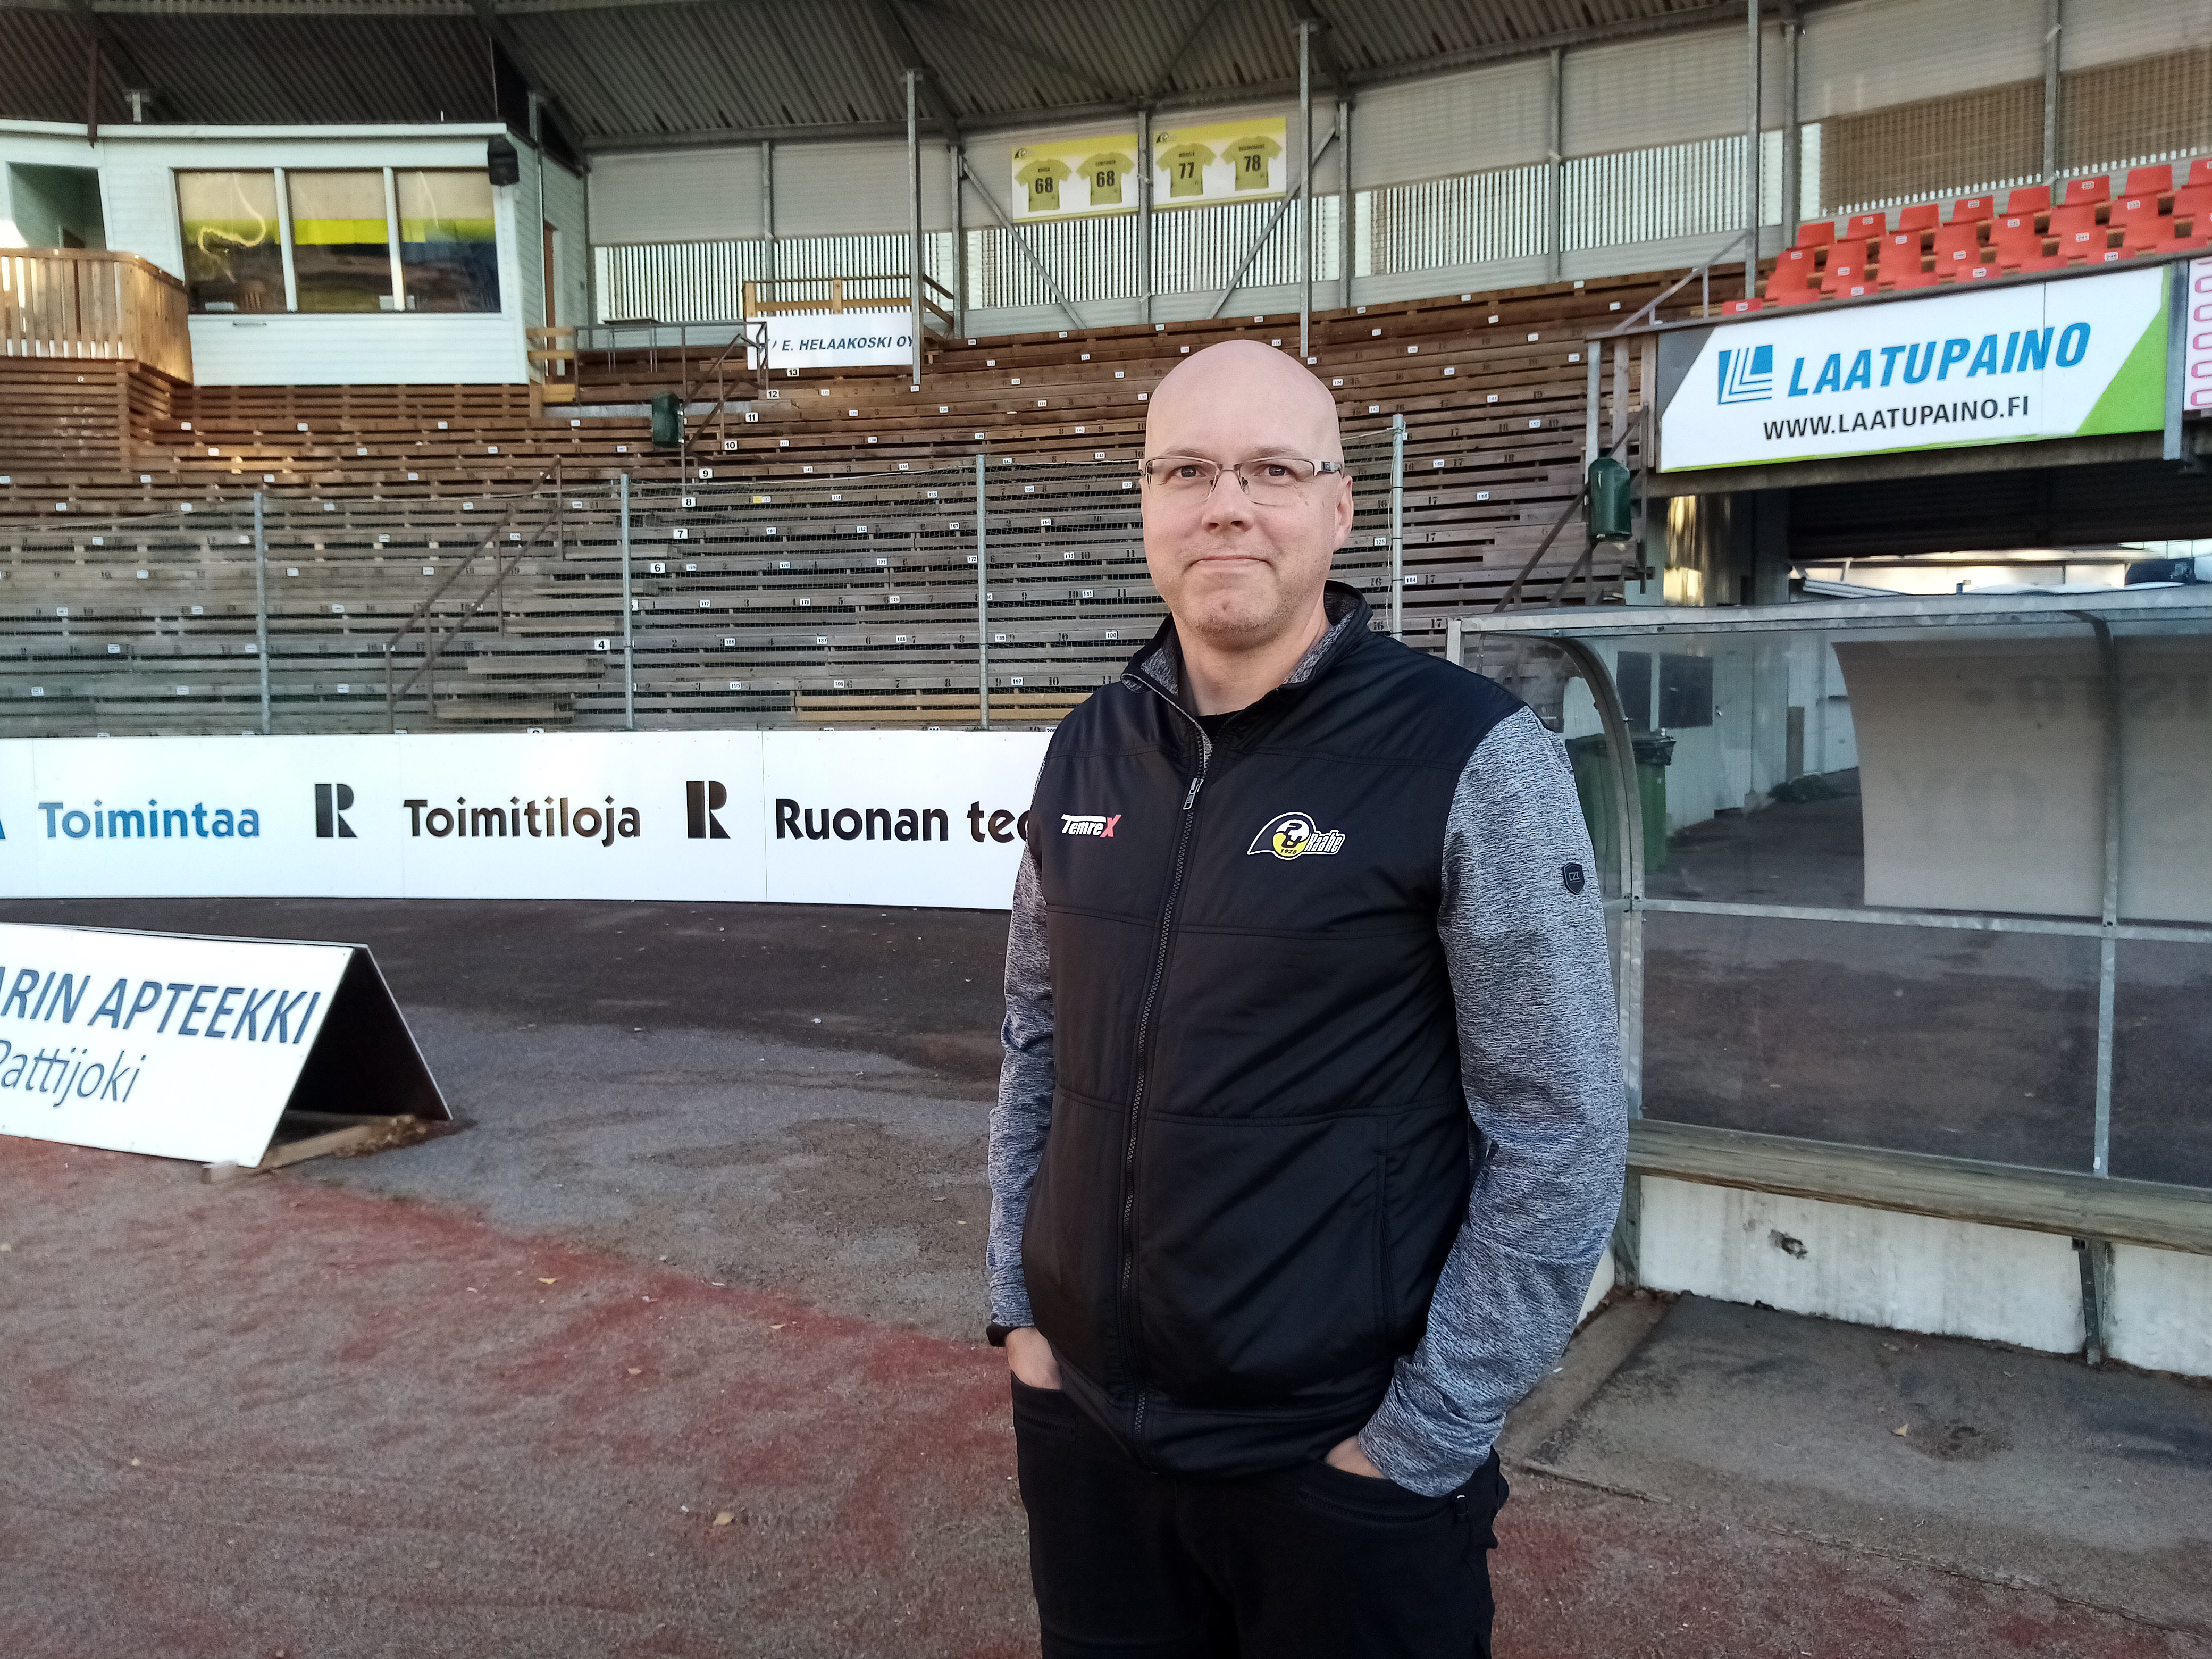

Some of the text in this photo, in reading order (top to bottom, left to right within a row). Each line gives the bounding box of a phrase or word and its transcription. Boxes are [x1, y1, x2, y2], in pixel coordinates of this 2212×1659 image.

[1179, 162, 1195, 179] 77
[1244, 154, 1261, 172] 78
[1035, 177, 1053, 194] 68
[1096, 170, 1115, 188] 68
[782, 340, 794, 351] E.
[799, 336, 893, 351] HELAAKOSKI
[1787, 322, 2092, 397] LAATUPAINO
[1763, 395, 2030, 440] WWW.LAATUPAINO.FI
[1425, 575, 1435, 584] 17
[1069, 590, 1078, 599] 10
[1431, 619, 1442, 629] 17
[598, 641, 605, 650] 4
[1048, 677, 1059, 685] 10
[38, 798, 260, 839] Toimintaa
[404, 796, 641, 848] Toimitiloja
[776, 798, 949, 842] Ruonan
[1303, 830, 1344, 852] Raahe
[87, 977, 321, 1045] APTEEKKI
